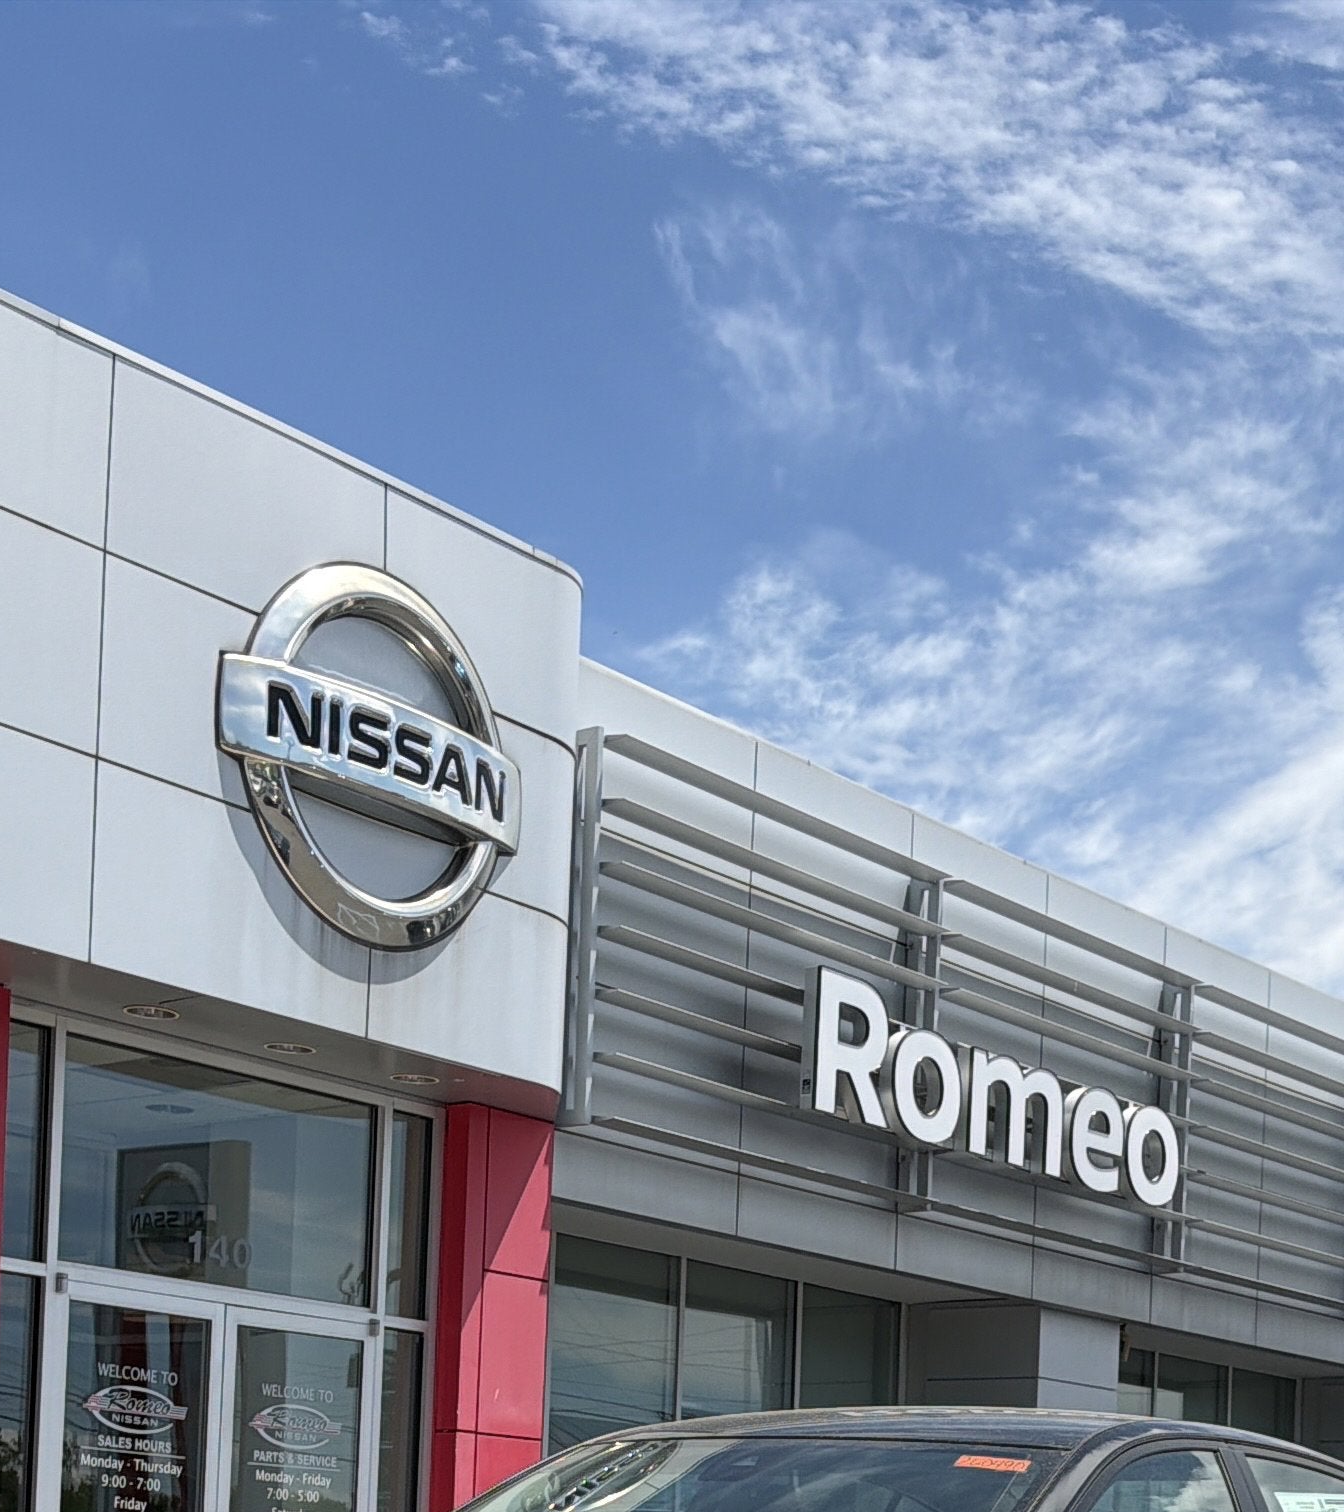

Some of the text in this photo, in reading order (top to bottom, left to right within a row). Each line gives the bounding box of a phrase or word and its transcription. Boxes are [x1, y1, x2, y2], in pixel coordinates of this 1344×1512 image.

[265, 680, 506, 823] NISSAN
[812, 965, 1180, 1206] Romeo
[188, 1230, 252, 1270] 140
[97, 1362, 179, 1386] WELCOME TO
[104, 1389, 171, 1415] Romeo
[262, 1383, 334, 1403] WELCOME TO
[112, 1413, 159, 1426] NISSAN
[98, 1434, 172, 1454] SALES HOURS
[275, 1430, 316, 1442] NISSAN
[80, 1453, 124, 1472] Monday
[132, 1458, 183, 1478] Thursday
[253, 1450, 337, 1467] PARTS & SERVICE
[101, 1474, 127, 1489] 9:00
[136, 1477, 161, 1491] 7:00
[256, 1469, 294, 1486] Monday
[302, 1473, 332, 1489] Friday
[113, 1496, 148, 1512] Friday
[266, 1487, 289, 1500] 7:00
[297, 1489, 320, 1502] 5:00
